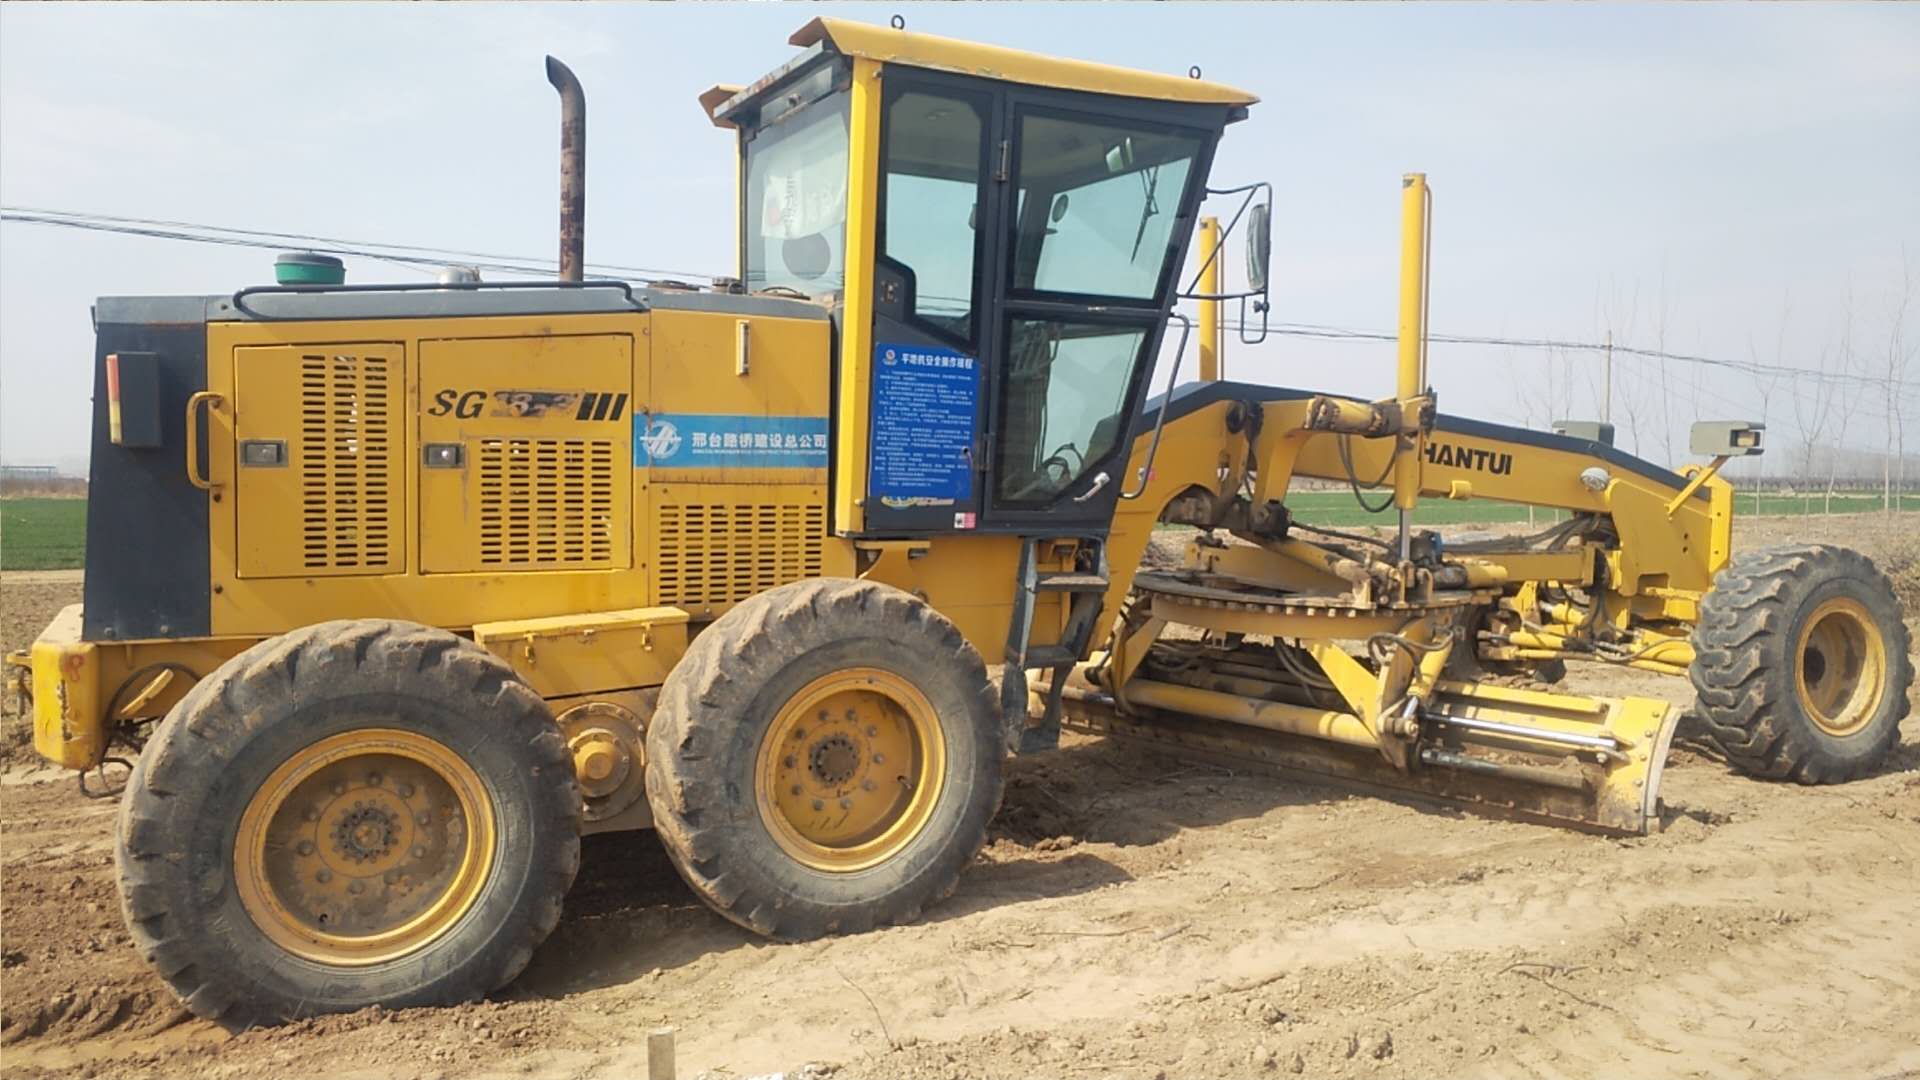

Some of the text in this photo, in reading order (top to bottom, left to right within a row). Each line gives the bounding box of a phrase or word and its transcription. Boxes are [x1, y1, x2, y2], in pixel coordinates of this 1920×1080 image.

[428, 389, 487, 419] SG
[691, 432, 827, 448] 邢台路桥建设总公司
